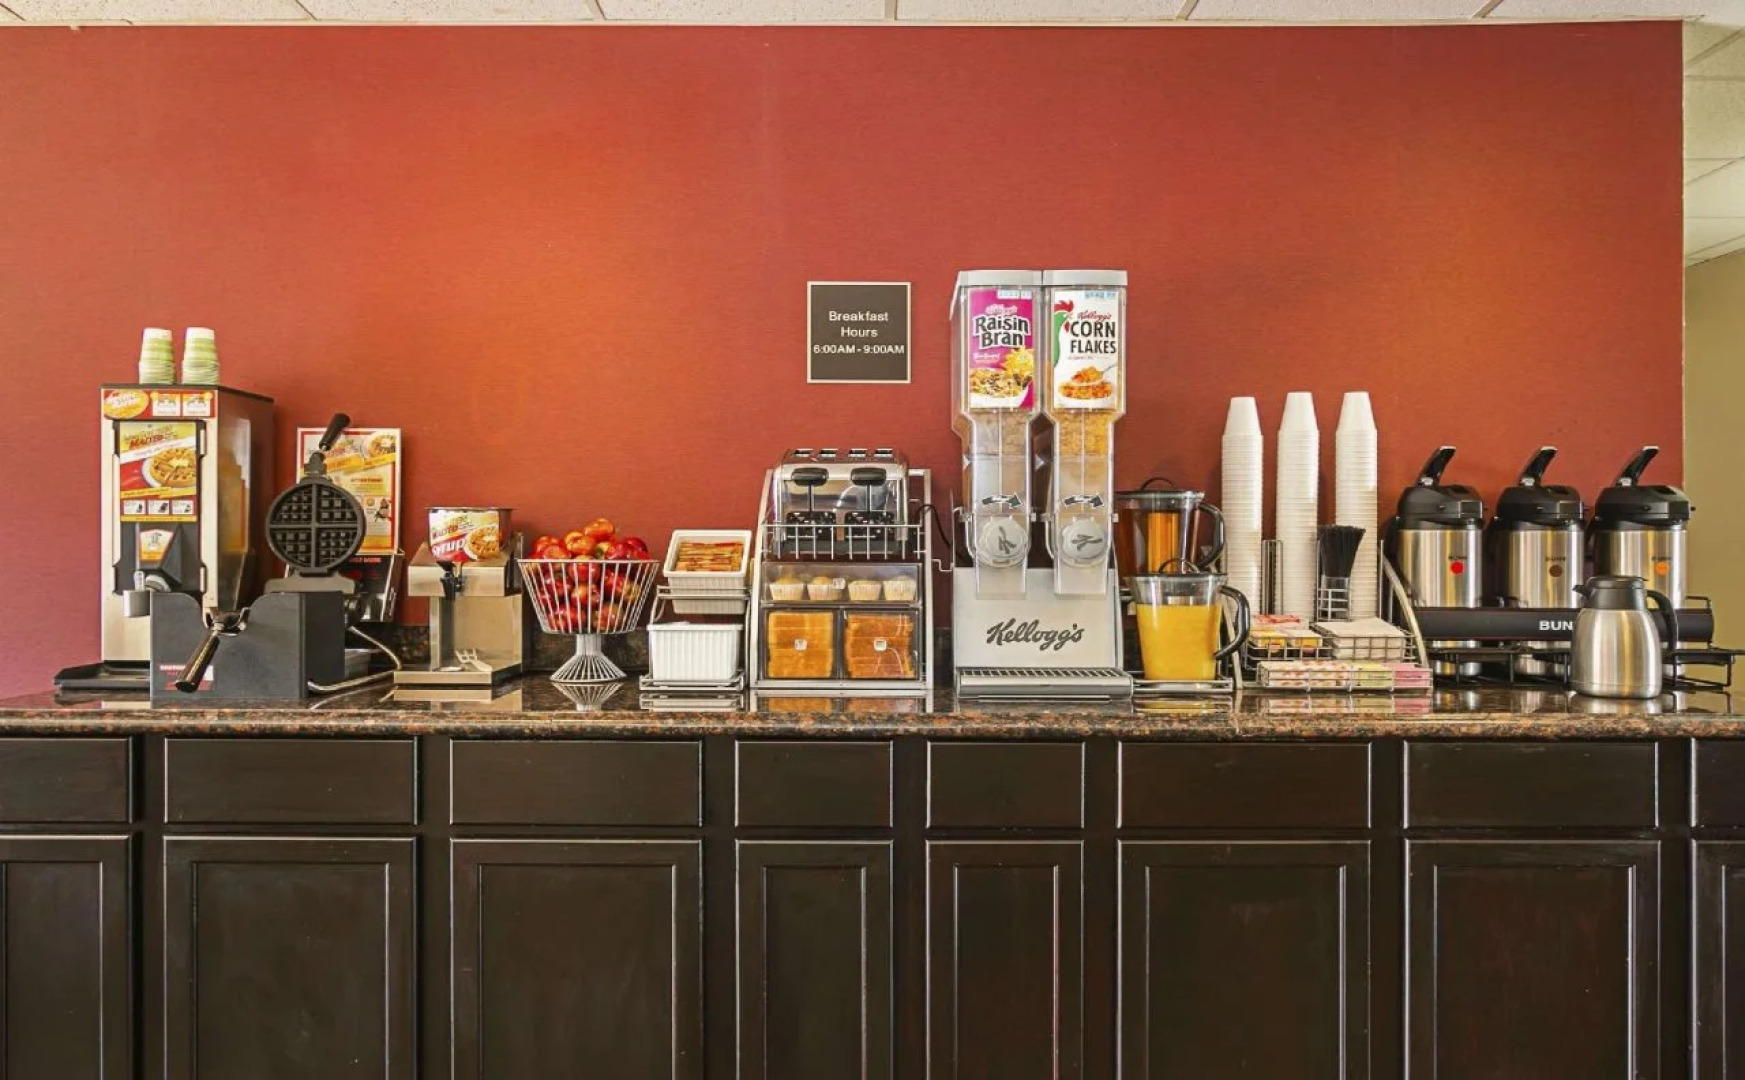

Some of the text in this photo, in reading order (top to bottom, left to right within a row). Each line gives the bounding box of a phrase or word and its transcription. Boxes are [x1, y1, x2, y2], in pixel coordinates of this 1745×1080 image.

[828, 310, 890, 322] Breakfast
[840, 326, 879, 338] Hours
[975, 316, 1029, 335] Raisin
[1070, 321, 1115, 338] CORN
[982, 332, 1023, 347] Bran
[813, 344, 856, 354] 6:00AM
[863, 344, 905, 354] 9:00AM
[1070, 340, 1117, 354] FLAKES
[1540, 620, 1575, 631] BUN
[987, 617, 1085, 651] Kellogg's
